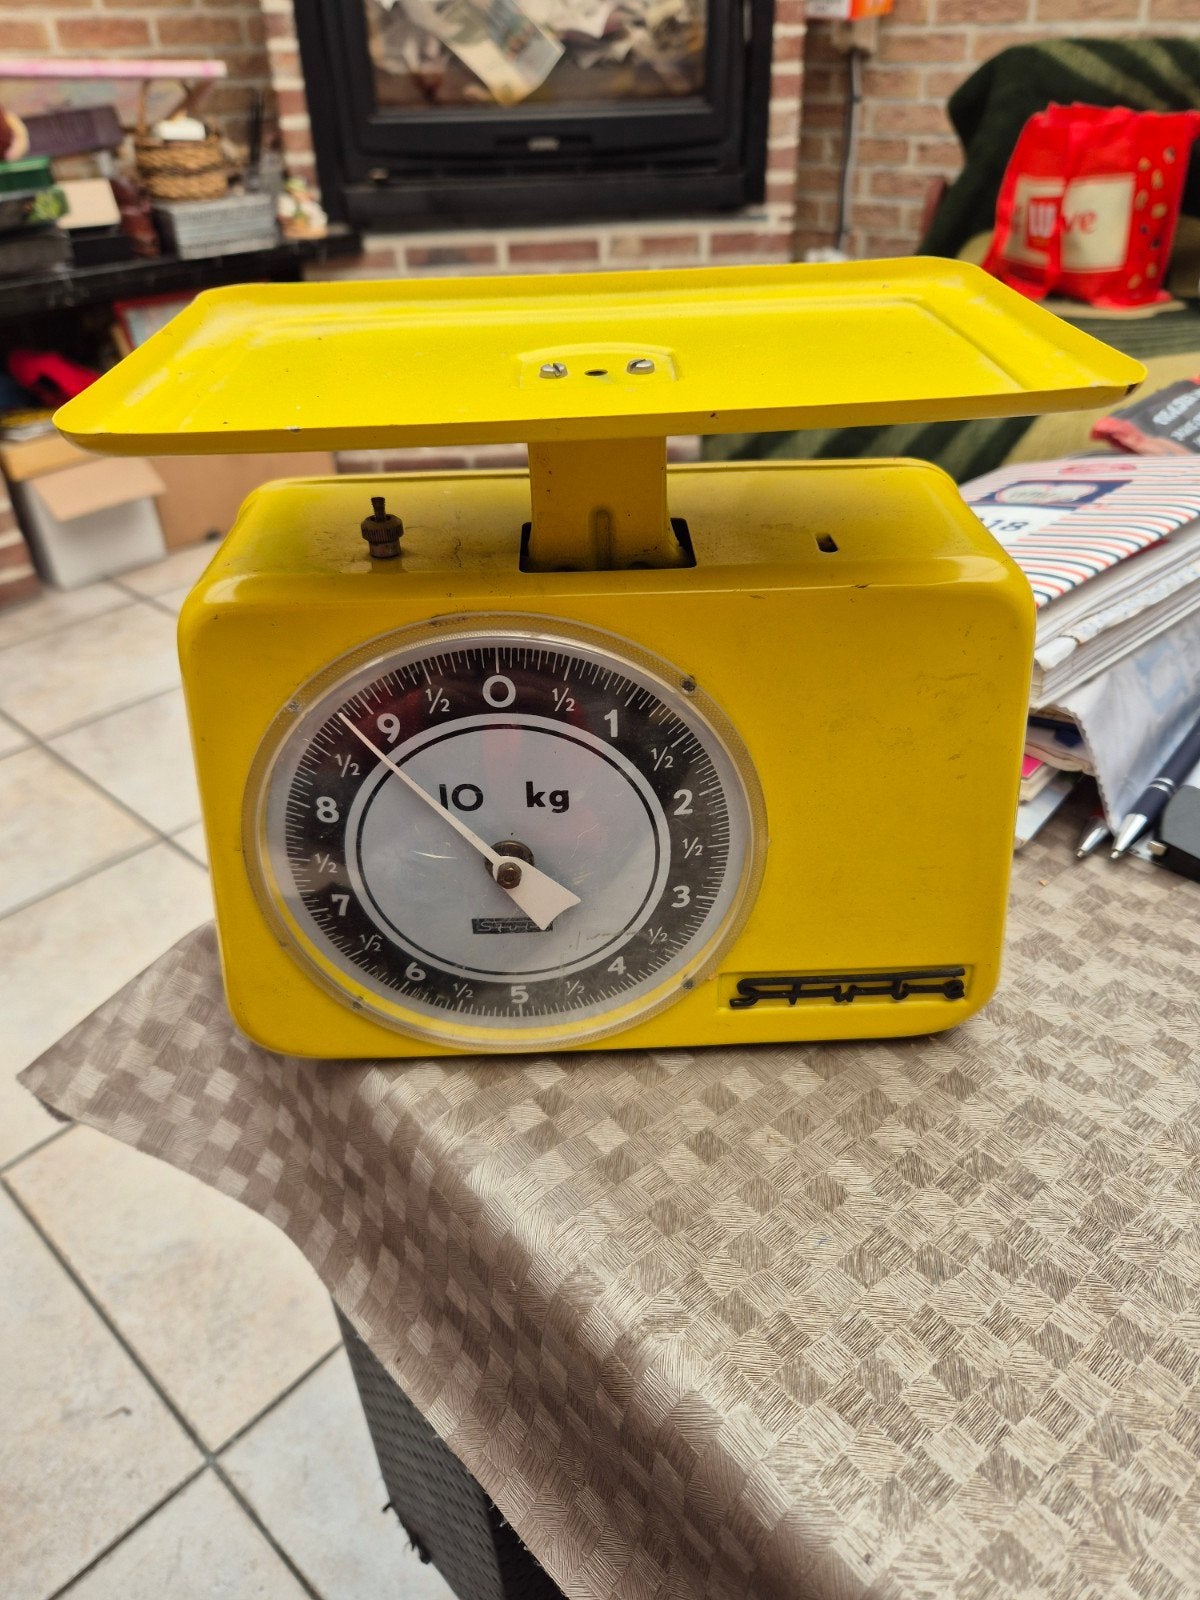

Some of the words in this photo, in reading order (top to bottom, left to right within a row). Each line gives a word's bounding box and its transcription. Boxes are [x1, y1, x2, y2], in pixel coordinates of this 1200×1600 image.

[482, 674, 516, 708] 0
[376, 713, 400, 744] 9
[604, 709, 619, 738] 1
[316, 796, 340, 824] 8
[439, 783, 484, 812] 10
[526, 781, 570, 813] kg
[673, 789, 693, 816] 2
[331, 894, 350, 917] 7
[671, 885, 691, 908] 3
[405, 962, 426, 981] 6
[607, 956, 627, 975] 4
[510, 985, 530, 1004] 5
